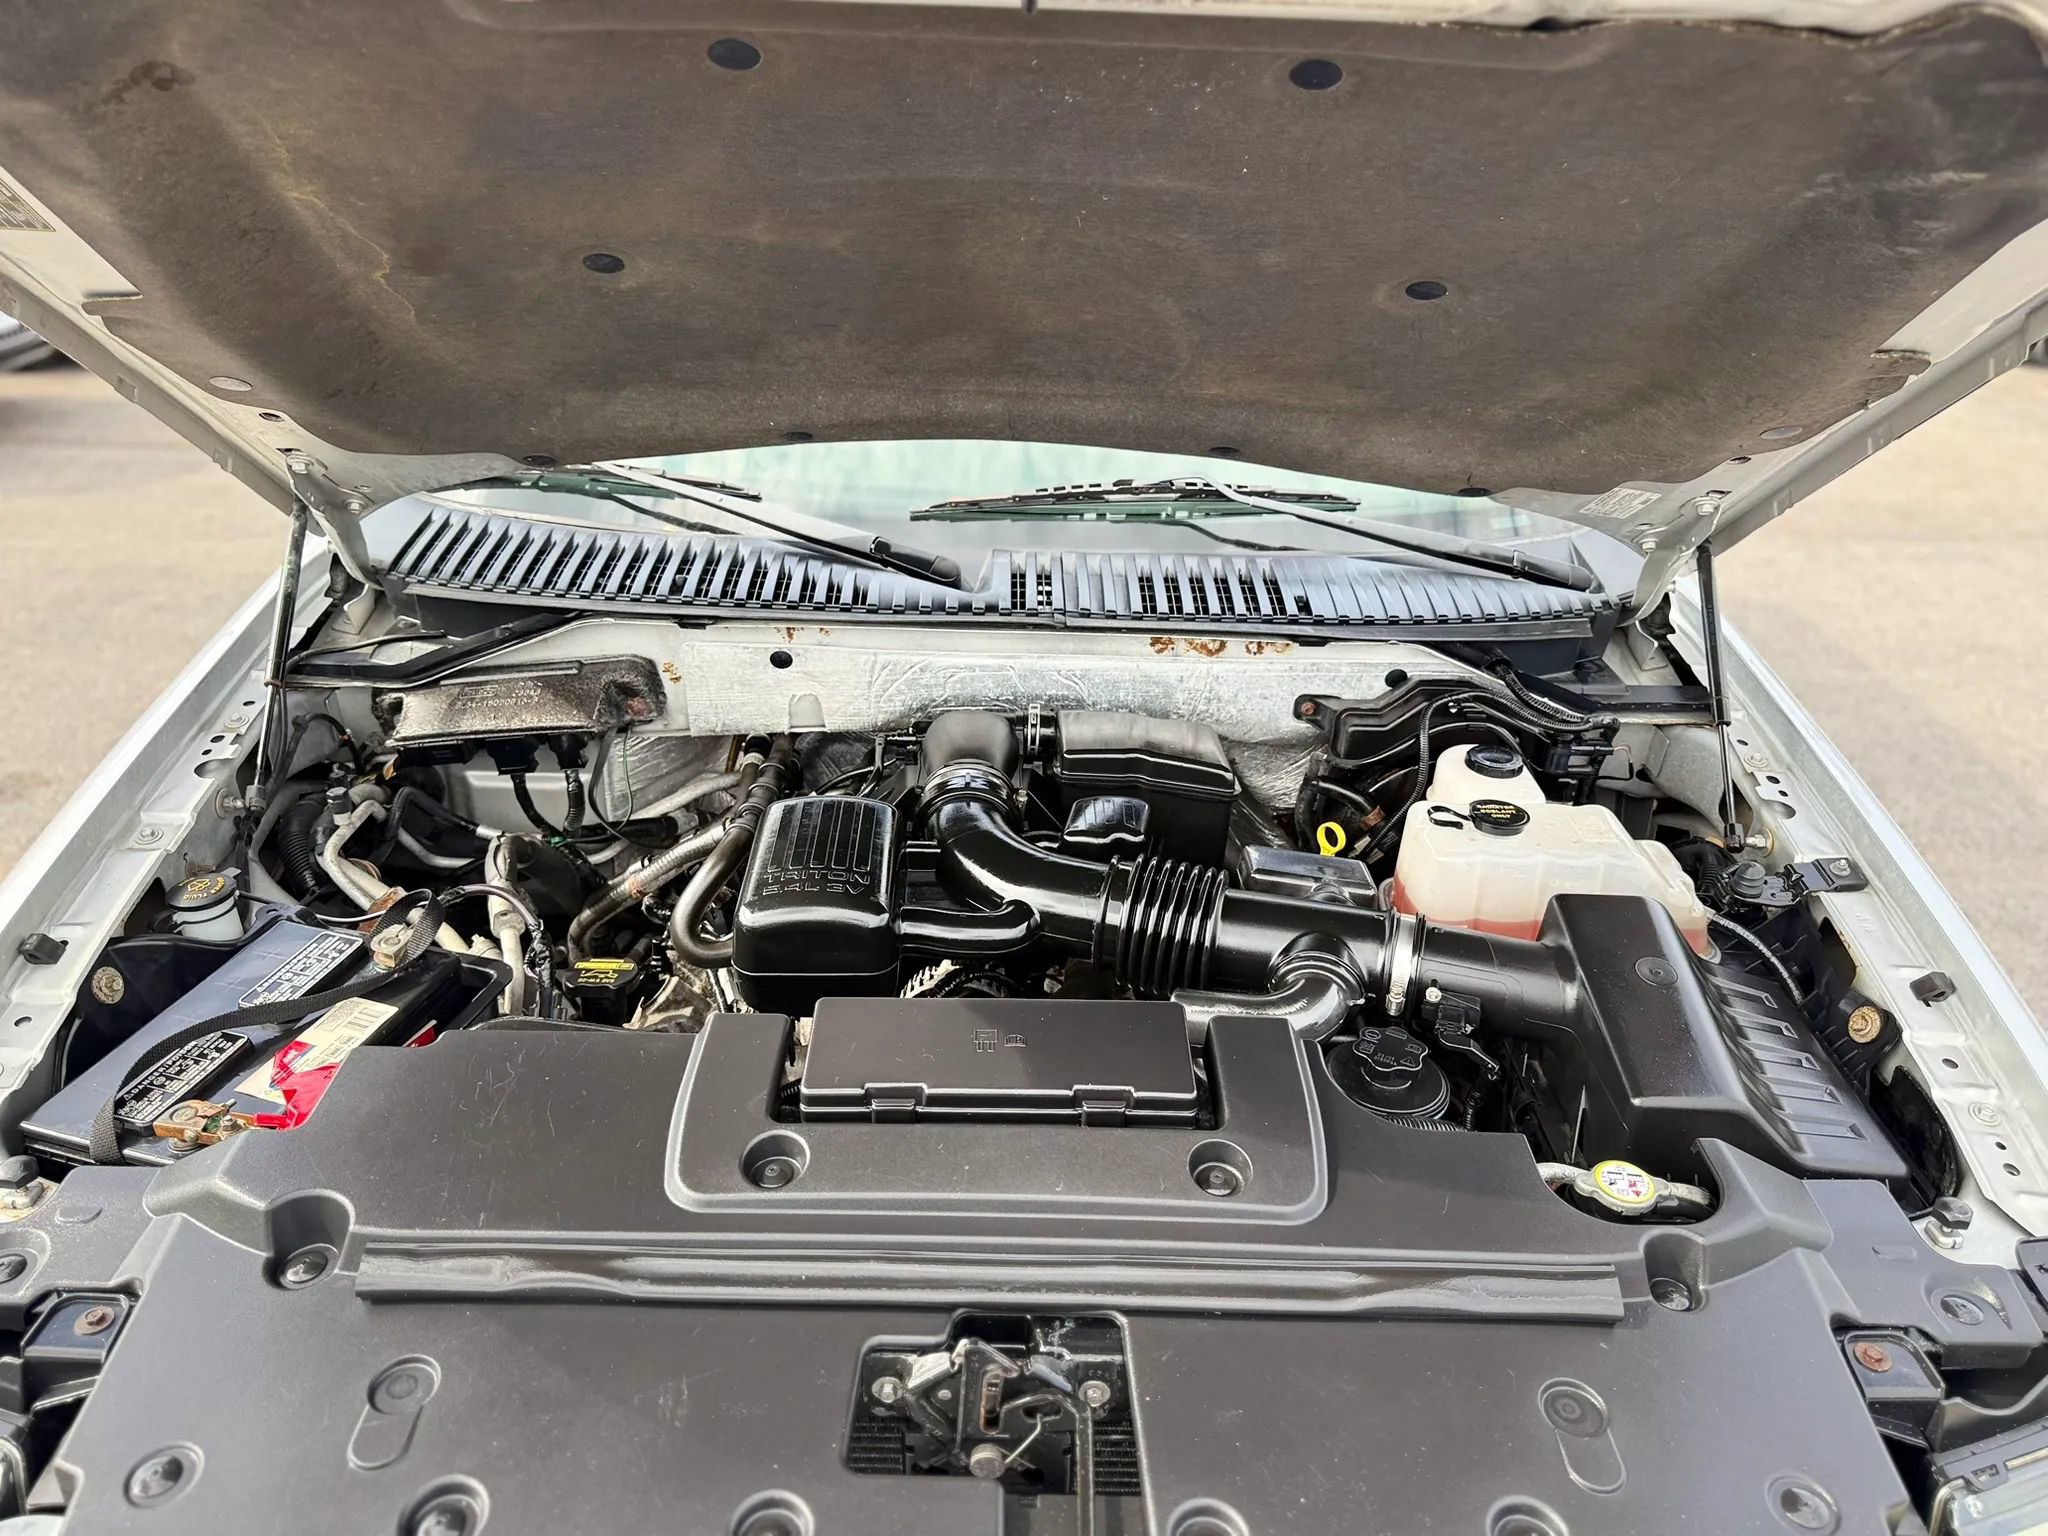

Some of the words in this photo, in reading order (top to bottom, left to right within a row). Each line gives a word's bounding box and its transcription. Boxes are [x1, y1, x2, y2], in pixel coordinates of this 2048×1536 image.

[763, 870, 871, 885] TRITON
[183, 892, 208, 900] FLUID
[762, 882, 820, 896] 5.4L
[826, 883, 865, 895] 3V
